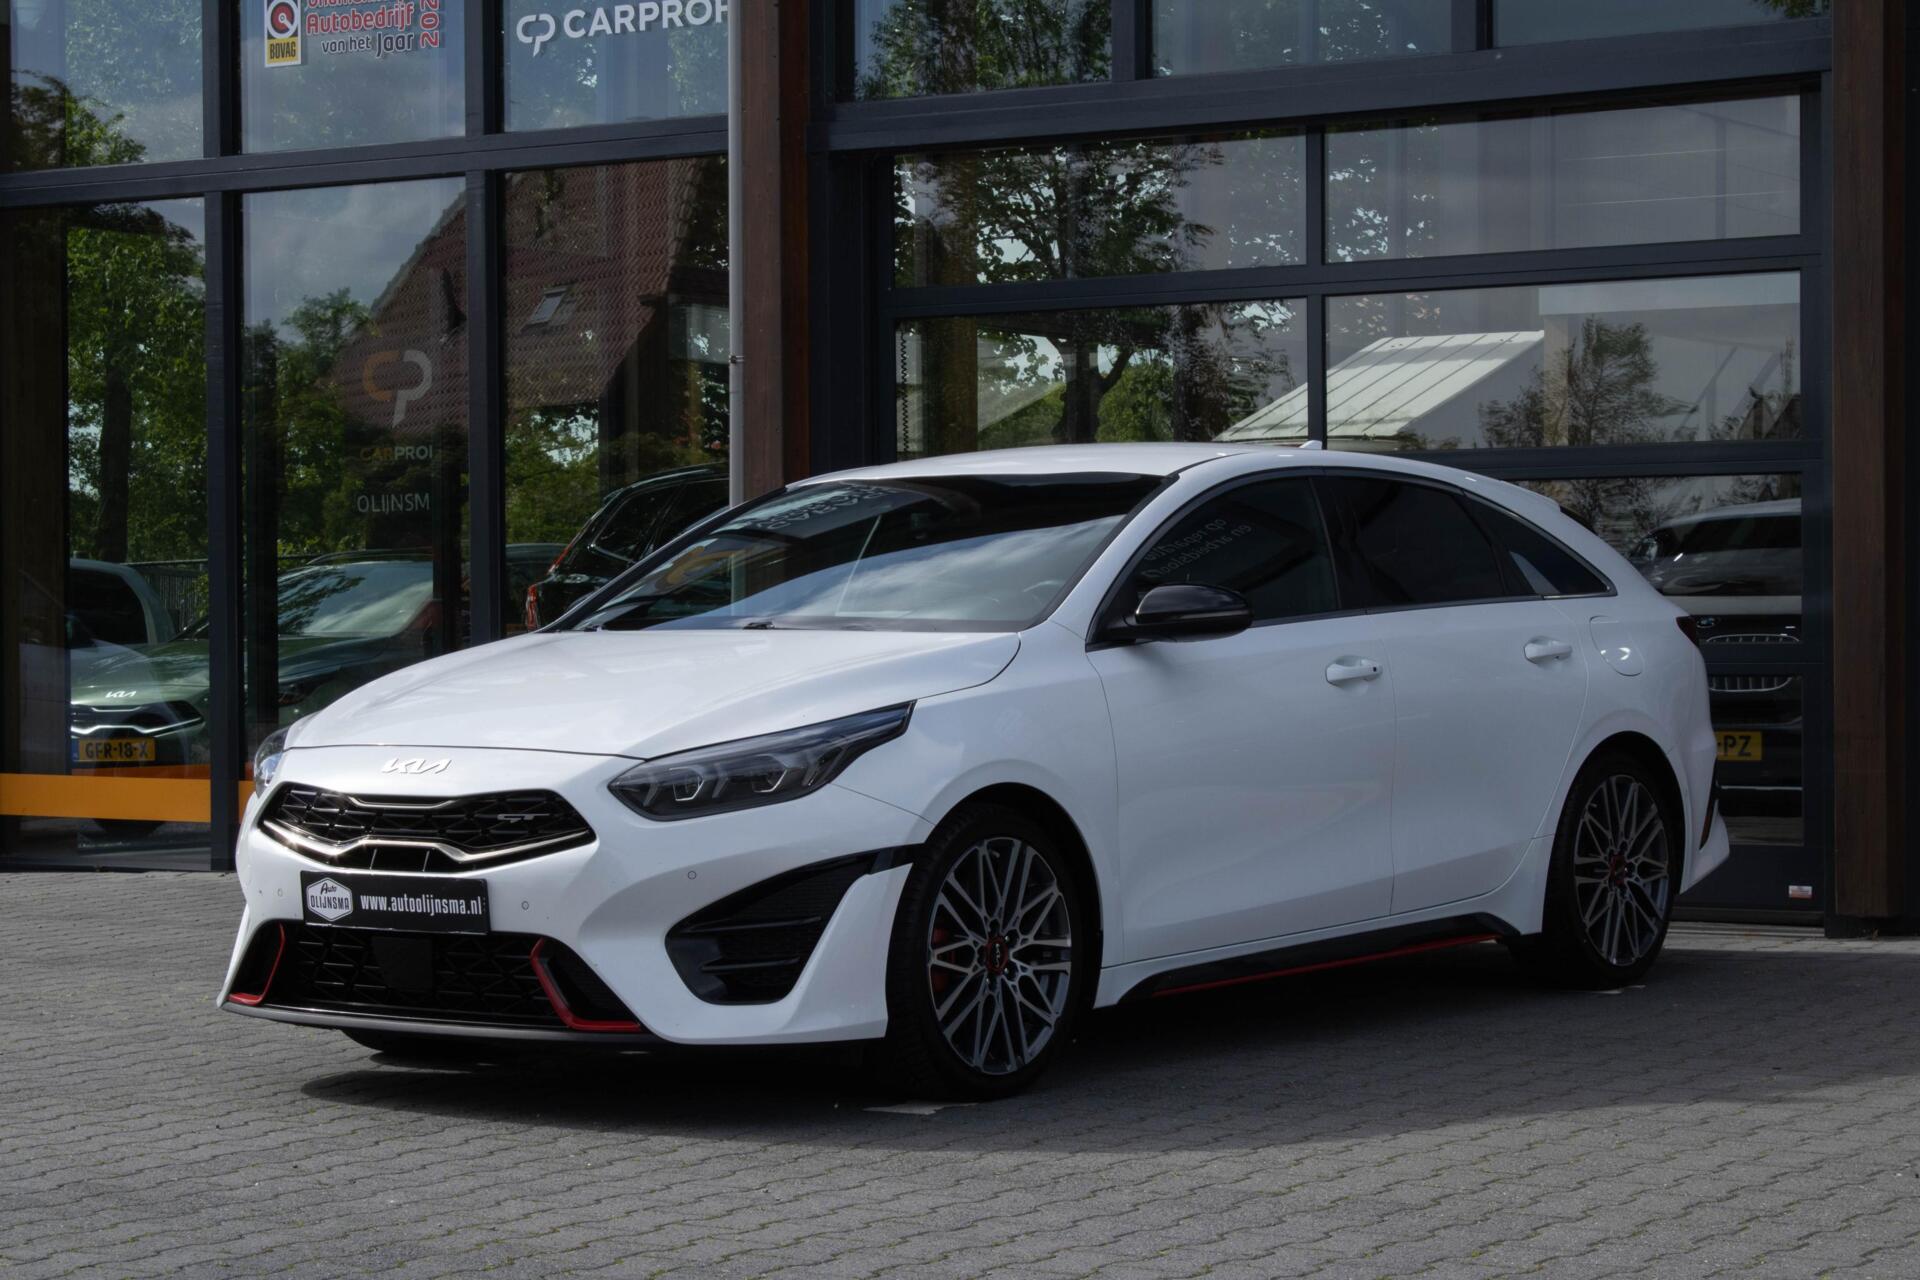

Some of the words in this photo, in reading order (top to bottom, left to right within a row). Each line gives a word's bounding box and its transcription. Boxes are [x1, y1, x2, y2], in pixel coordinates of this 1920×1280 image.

[306, 1, 415, 36] Autobedrijf
[269, 41, 296, 60] BOVAG
[322, 39, 345, 53] van
[348, 36, 371, 50] het
[310, 894, 350, 911] OLIJNSMA
[359, 893, 483, 917] www.autoolijnsma.nl
